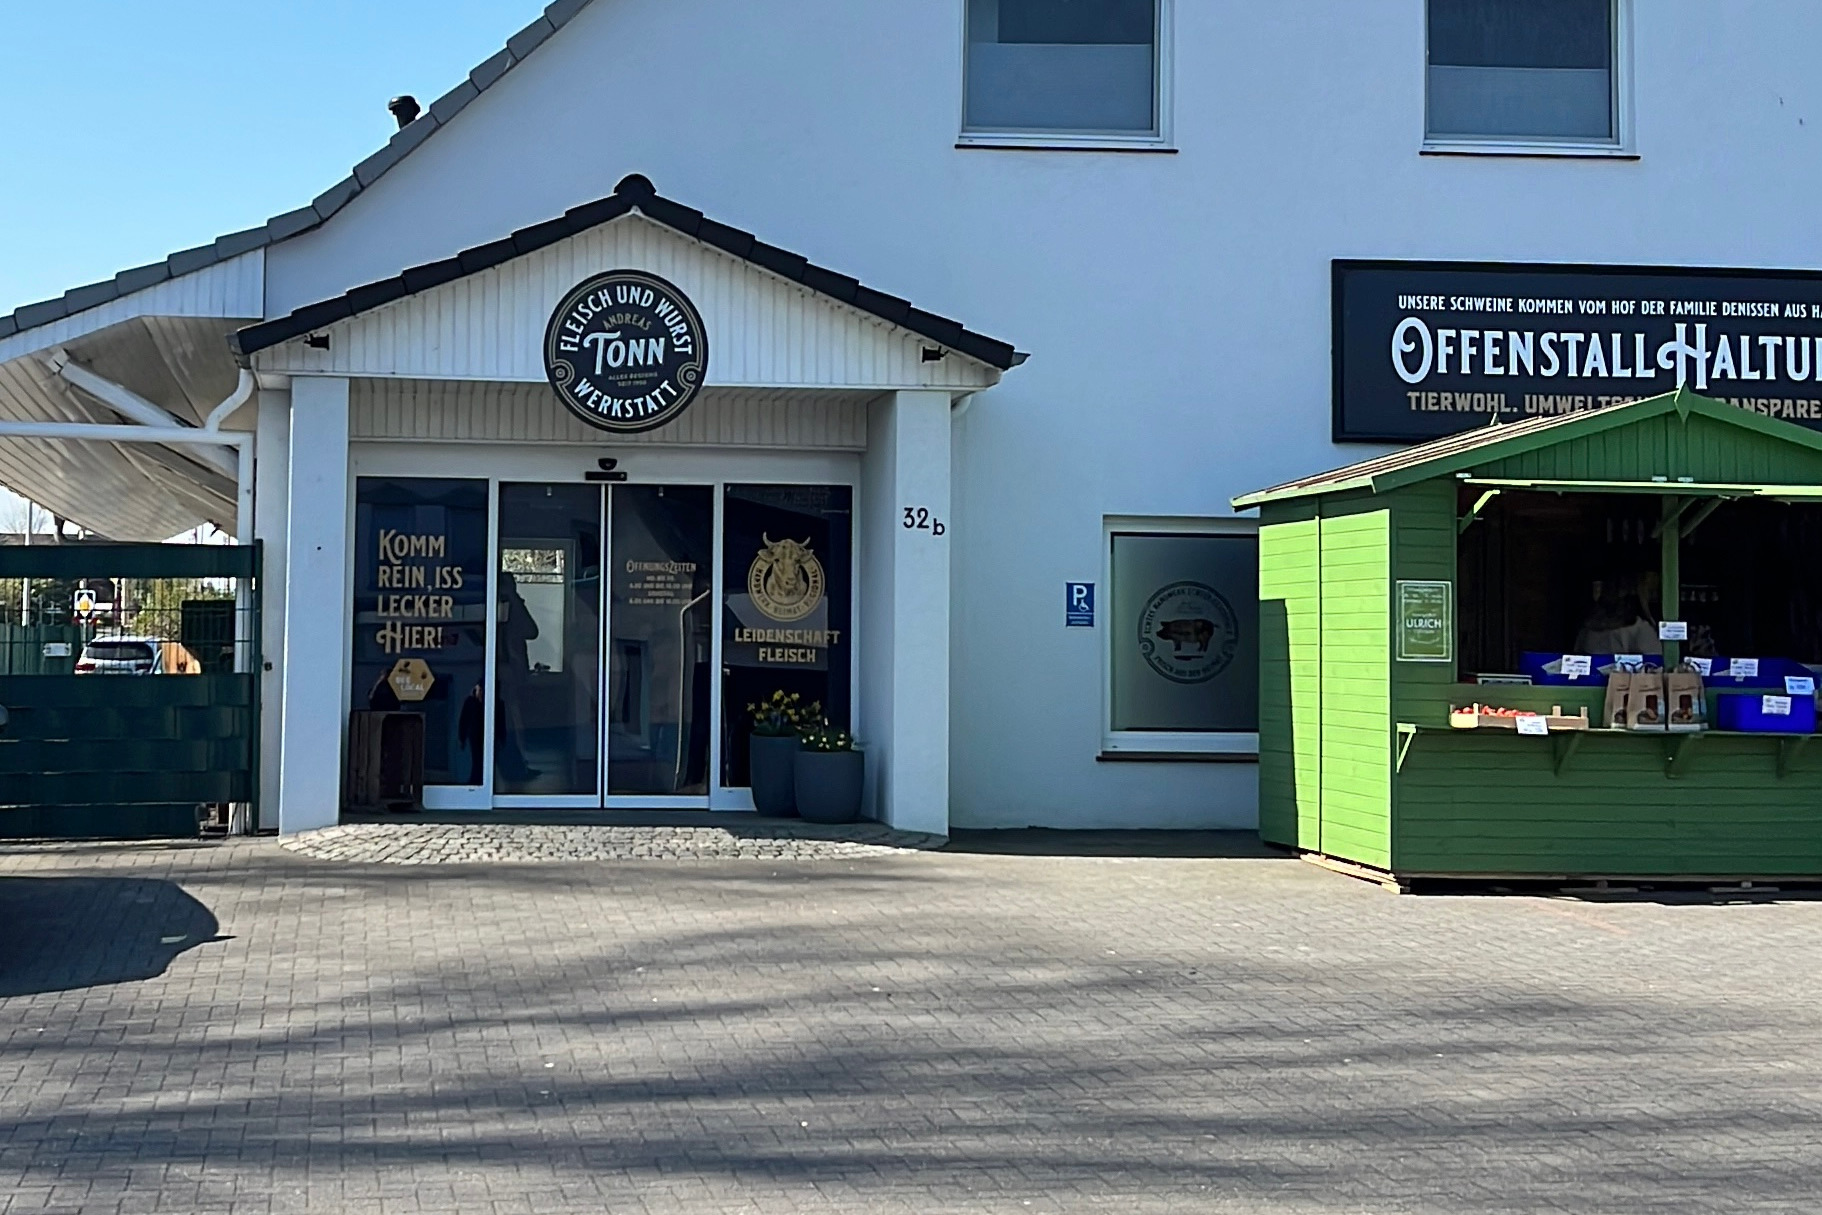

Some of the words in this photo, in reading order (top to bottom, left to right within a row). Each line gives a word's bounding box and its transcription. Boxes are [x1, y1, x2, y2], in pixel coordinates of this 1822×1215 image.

[1399, 295, 1445, 310] UNSERE
[1450, 296, 1513, 312] SCHWEINE
[1518, 298, 1573, 314] KOMMEN
[1578, 300, 1606, 314] VOM
[1611, 300, 1636, 314] HOF
[1641, 301, 1665, 315] DER
[1670, 301, 1717, 316] FAMILIE
[1722, 302, 1779, 317] DENISSEN
[1784, 304, 1807, 318] AUS
[1812, 305, 1822, 318] H
[560, 288, 613, 351] FLEISCH
[616, 285, 654, 307] UND
[654, 297, 692, 355] WURST
[602, 313, 652, 331] ANDREAS
[583, 331, 665, 375] TONN
[574, 377, 677, 418] WERKSTATT
[1406, 391, 1518, 413] TIERWOHL.
[379, 529, 445, 564] KOMM
[435, 567, 463, 589] ISS
[378, 595, 453, 618] LECKER
[1073, 585, 1087, 606] P
[1406, 619, 1441, 628] ULRICH
[376, 621, 443, 653] HIER!
[734, 627, 840, 644] LEIDENSCHAFT
[758, 647, 816, 663] FLEISCH
